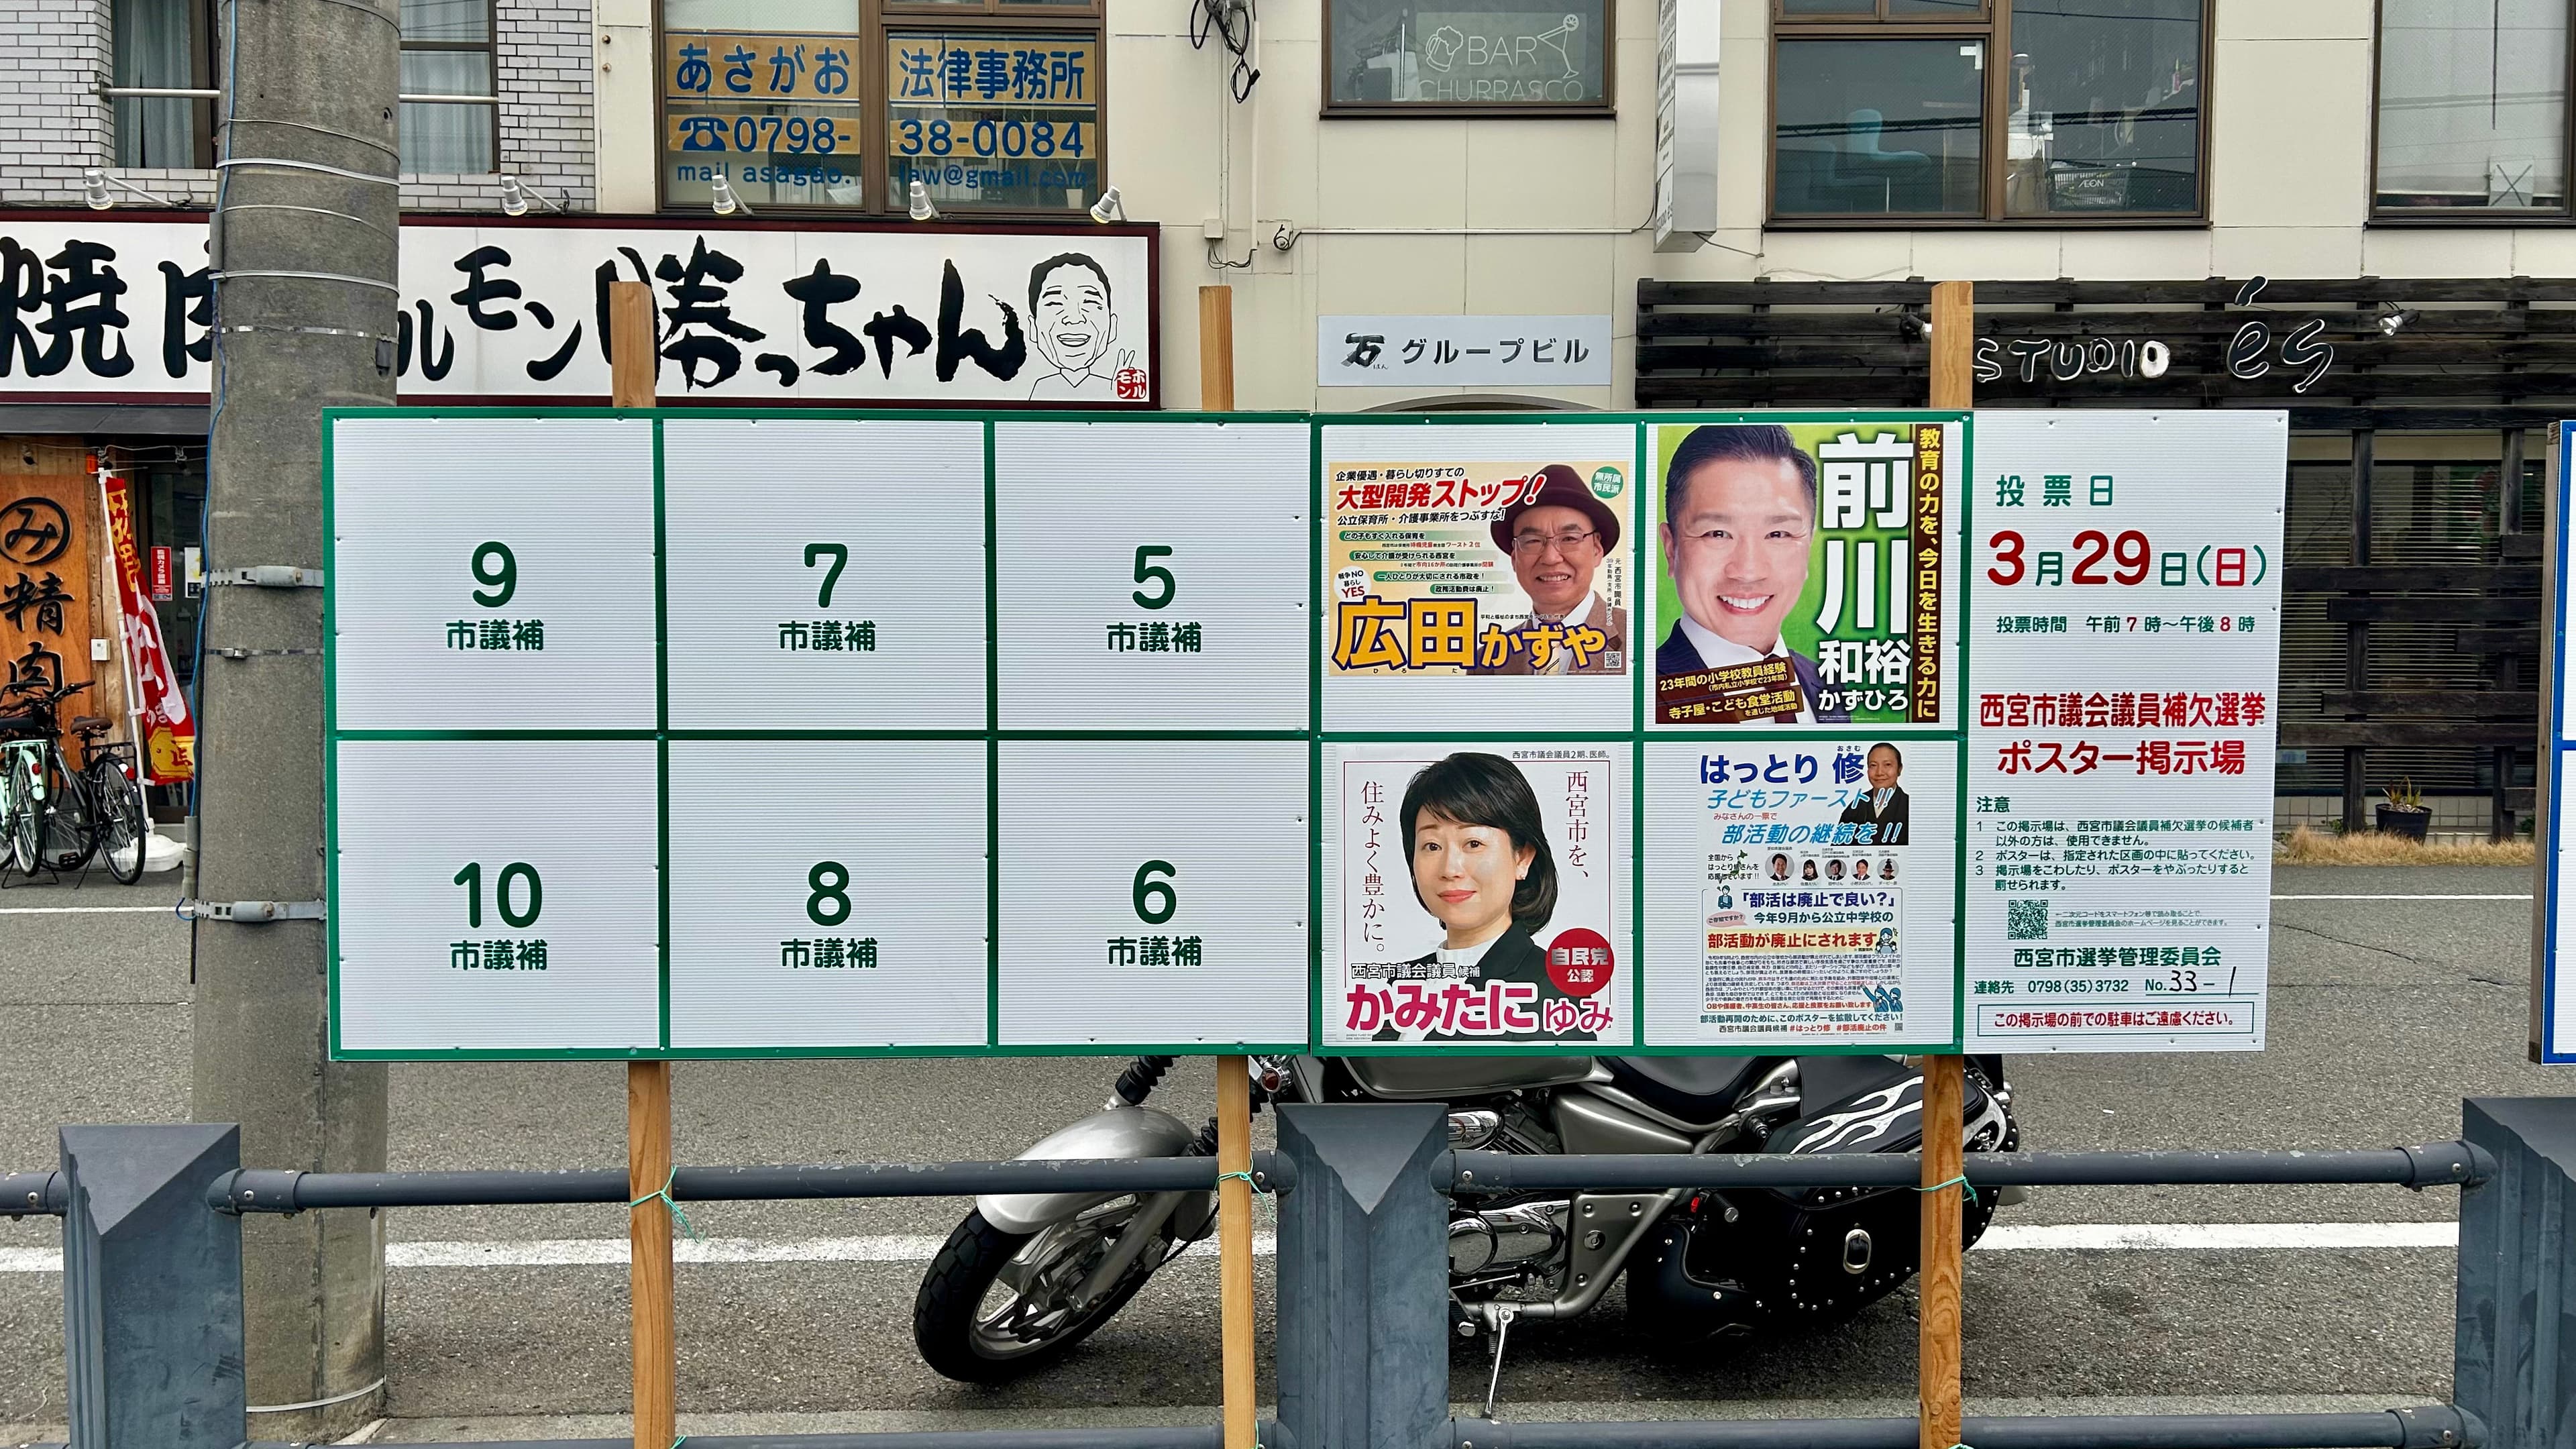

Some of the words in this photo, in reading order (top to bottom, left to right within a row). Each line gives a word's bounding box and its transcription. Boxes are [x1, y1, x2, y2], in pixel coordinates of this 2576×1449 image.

[1468, 36, 1537, 65] BAR
[676, 43, 849, 95] あさがお
[900, 49, 1085, 99] 法律事務所
[1418, 80, 1583, 102] CHURRASCO
[734, 116, 851, 154] 0798-
[899, 119, 1084, 158] 38-0084
[677, 162, 729, 183] mail
[596, 234, 1026, 392] 勝っちゃん
[1401, 337, 1589, 364] グループビル
[1973, 338, 2170, 382] STUDIO
[1593, 482, 1619, 494] 市民派
[1996, 474, 2113, 506] 投票日
[1817, 433, 1914, 635] 前川
[472, 541, 517, 608] 9
[804, 543, 849, 608] 7
[1132, 545, 1176, 610] 5
[1917, 428, 1940, 718] 教育の力を、今日を生きる力に
[1342, 586, 1364, 598] YES
[446, 619, 544, 651] 市議補
[778, 621, 876, 652] 市議補
[1107, 622, 1202, 653] 市議補
[1332, 596, 1478, 669] 広田
[1481, 622, 1609, 669] かずや
[1996, 616, 2067, 633] 投票時間
[1660, 662, 1787, 691] 23年間の小学校教員経験
[1819, 639, 1911, 685] 和裕
[1669, 690, 1795, 719] 寺子屋・こども食堂活動
[1819, 690, 1909, 711] かずひろ
[1980, 692, 2265, 727] 西宮市議会議員補欠選挙
[1701, 753, 1818, 784] はっとり
[1832, 753, 1865, 784] 修
[1998, 739, 2245, 775] ポスター掲示場
[1976, 796, 2010, 813] 注意
[1566, 770, 1589, 877] 西宮市を、
[1977, 822, 1982, 831] 1
[1976, 851, 1984, 861] 2
[1996, 835, 2150, 847] 以外の方は、使用できません。
[1360, 781, 1385, 952] 住みよく豊かに。
[1976, 865, 1984, 875] 3
[454, 862, 543, 928] 10
[807, 861, 852, 926] 8
[1133, 860, 1177, 925] 6
[1995, 879, 2067, 892] 罰せられます。
[1754, 911, 1893, 924] 今年9月から公立中学校の
[450, 939, 548, 971] 市議補
[781, 937, 878, 969] 市議補
[1108, 936, 1202, 967] 市議補
[1708, 932, 1877, 948] 部活動が廃止にされます
[1352, 963, 1457, 979] 西宮市議会議員
[1458, 965, 1481, 977] 候補
[1551, 947, 1609, 966] 自民党
[2014, 947, 2222, 967] 西宮市選挙管理委員会
[1567, 969, 1595, 983] 公認
[1974, 980, 2014, 994] 連絡先
[2028, 979, 2129, 993] 0798(35)3732
[1346, 983, 1536, 1030] かみたに
[1545, 1000, 1613, 1032] ゆみ
[1995, 1010, 2233, 1028] この掲示場の前での駐車はご遠慮ください。
